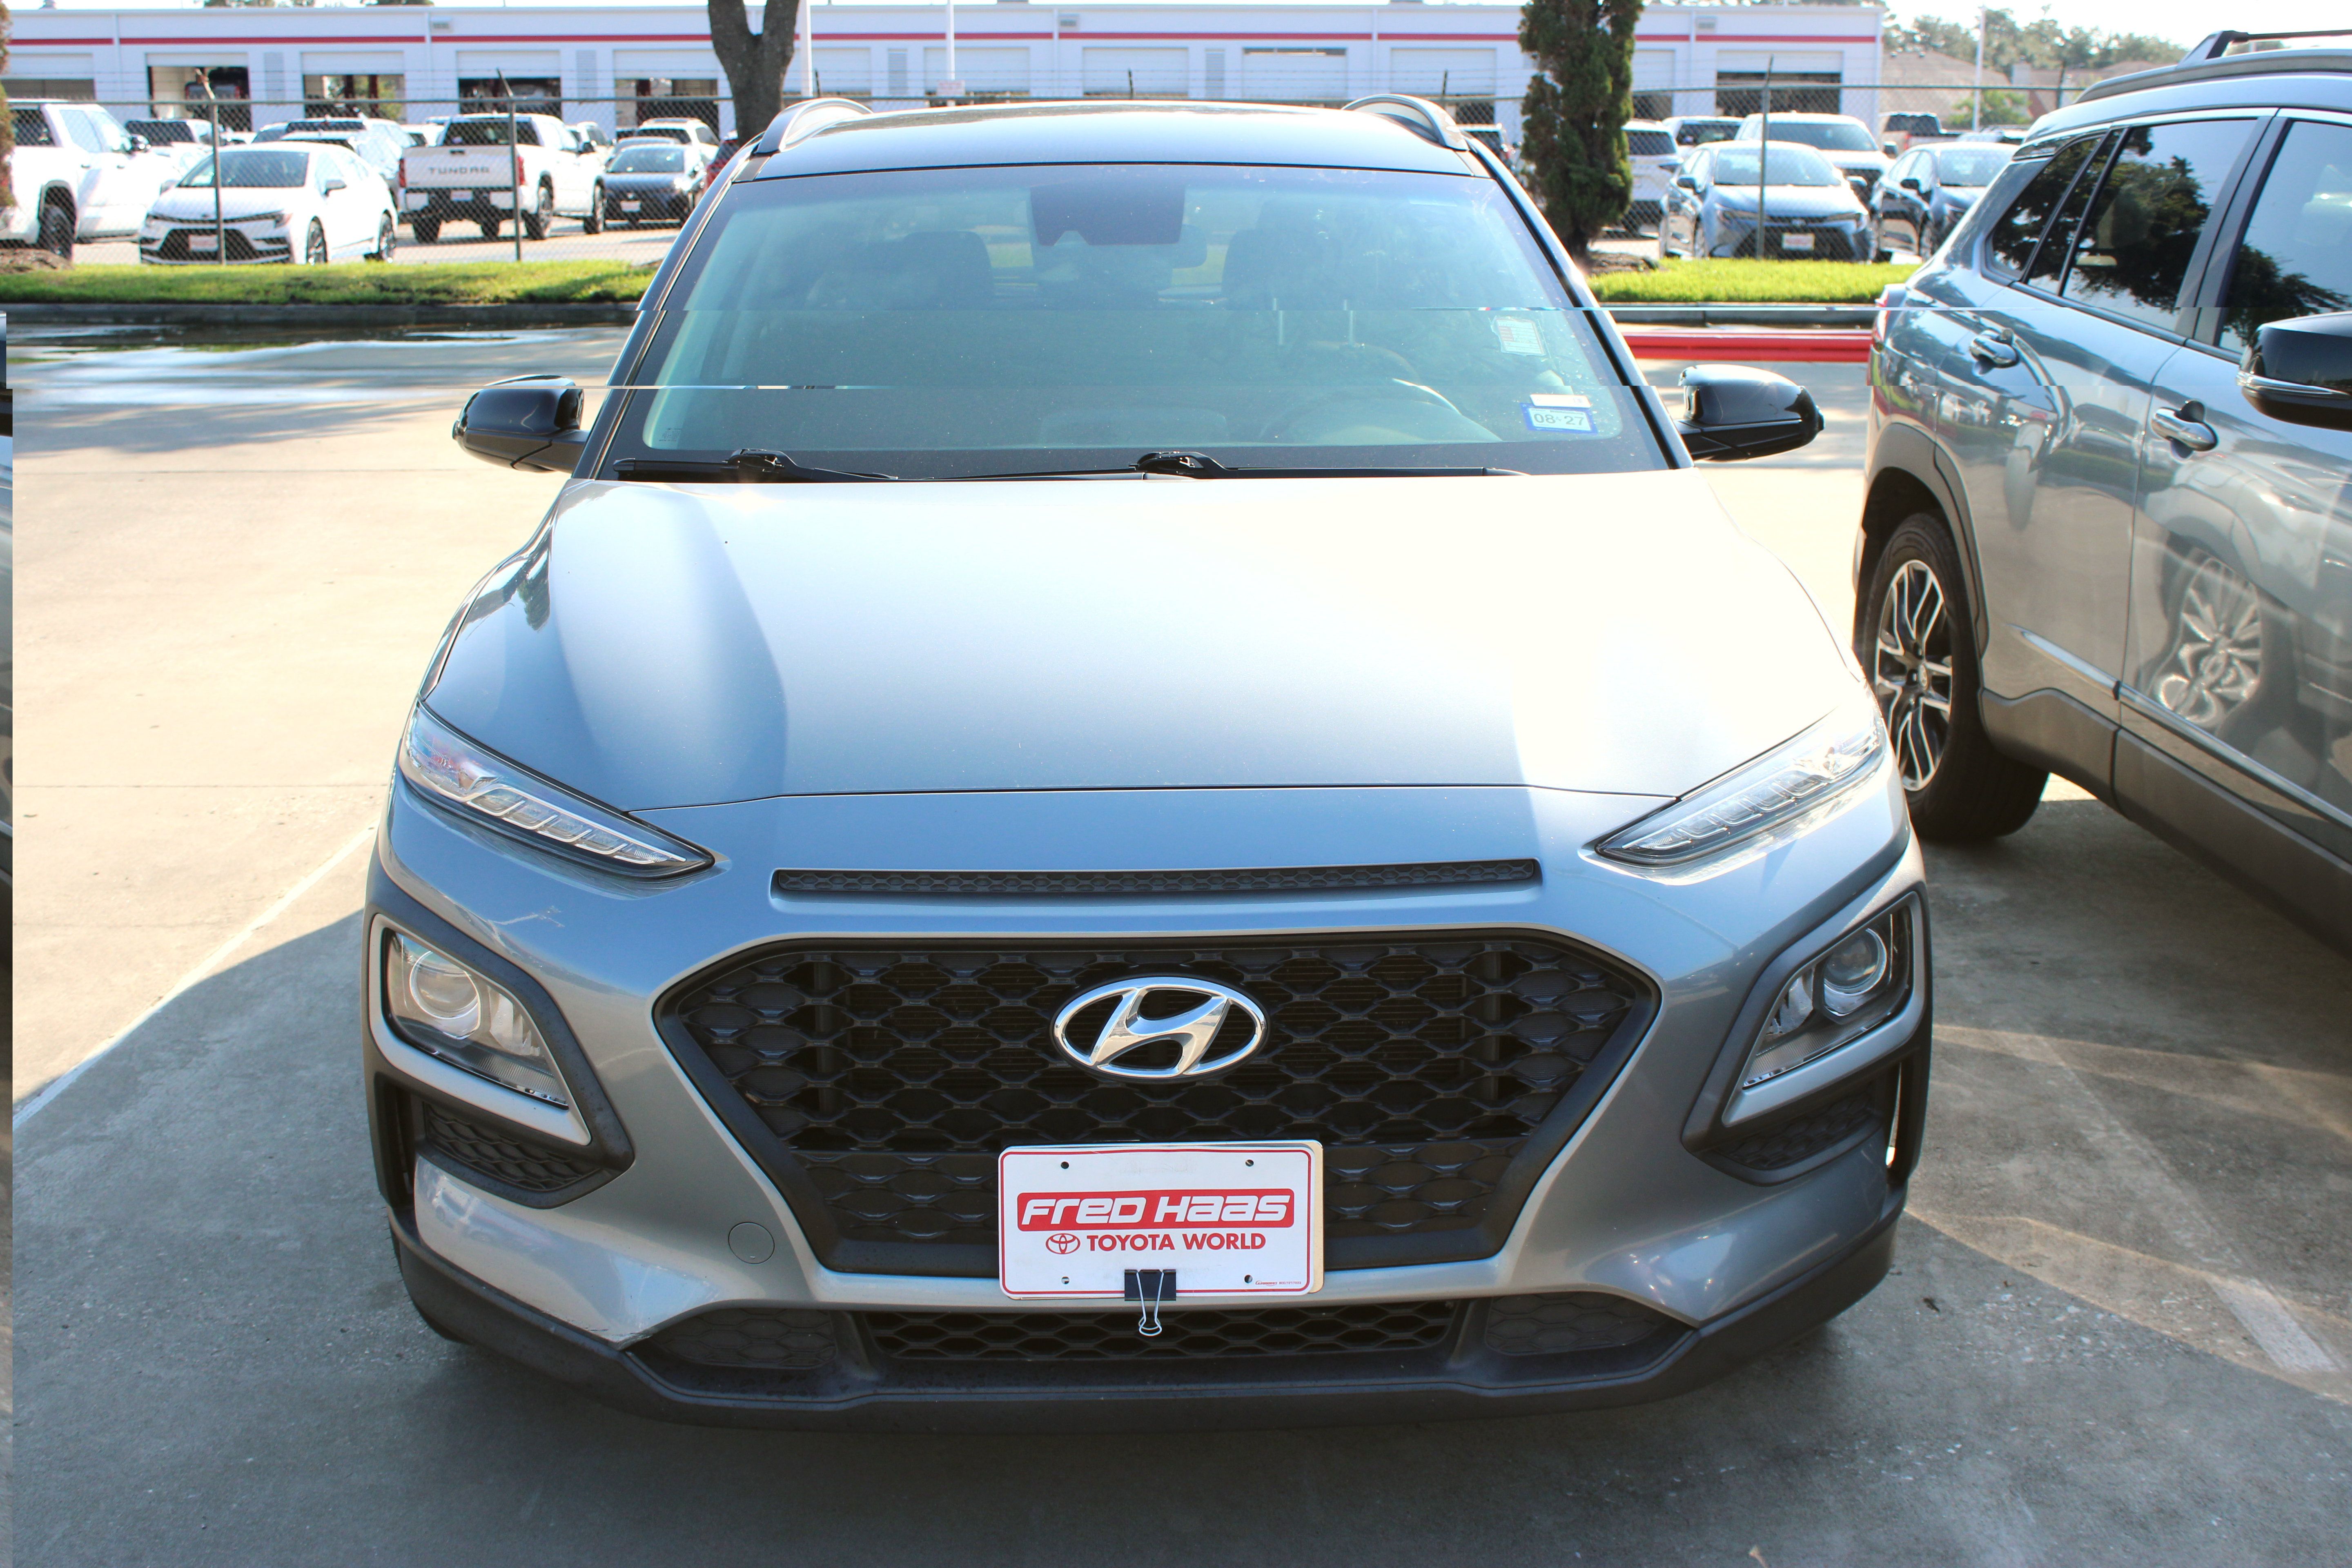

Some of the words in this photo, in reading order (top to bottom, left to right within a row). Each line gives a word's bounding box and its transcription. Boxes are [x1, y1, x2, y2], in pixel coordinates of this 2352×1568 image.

[1534, 413, 1556, 424] 08
[1564, 415, 1584, 425] 27
[1087, 1234, 1175, 1252] TOYOTA
[1182, 1233, 1266, 1250] WORLD
